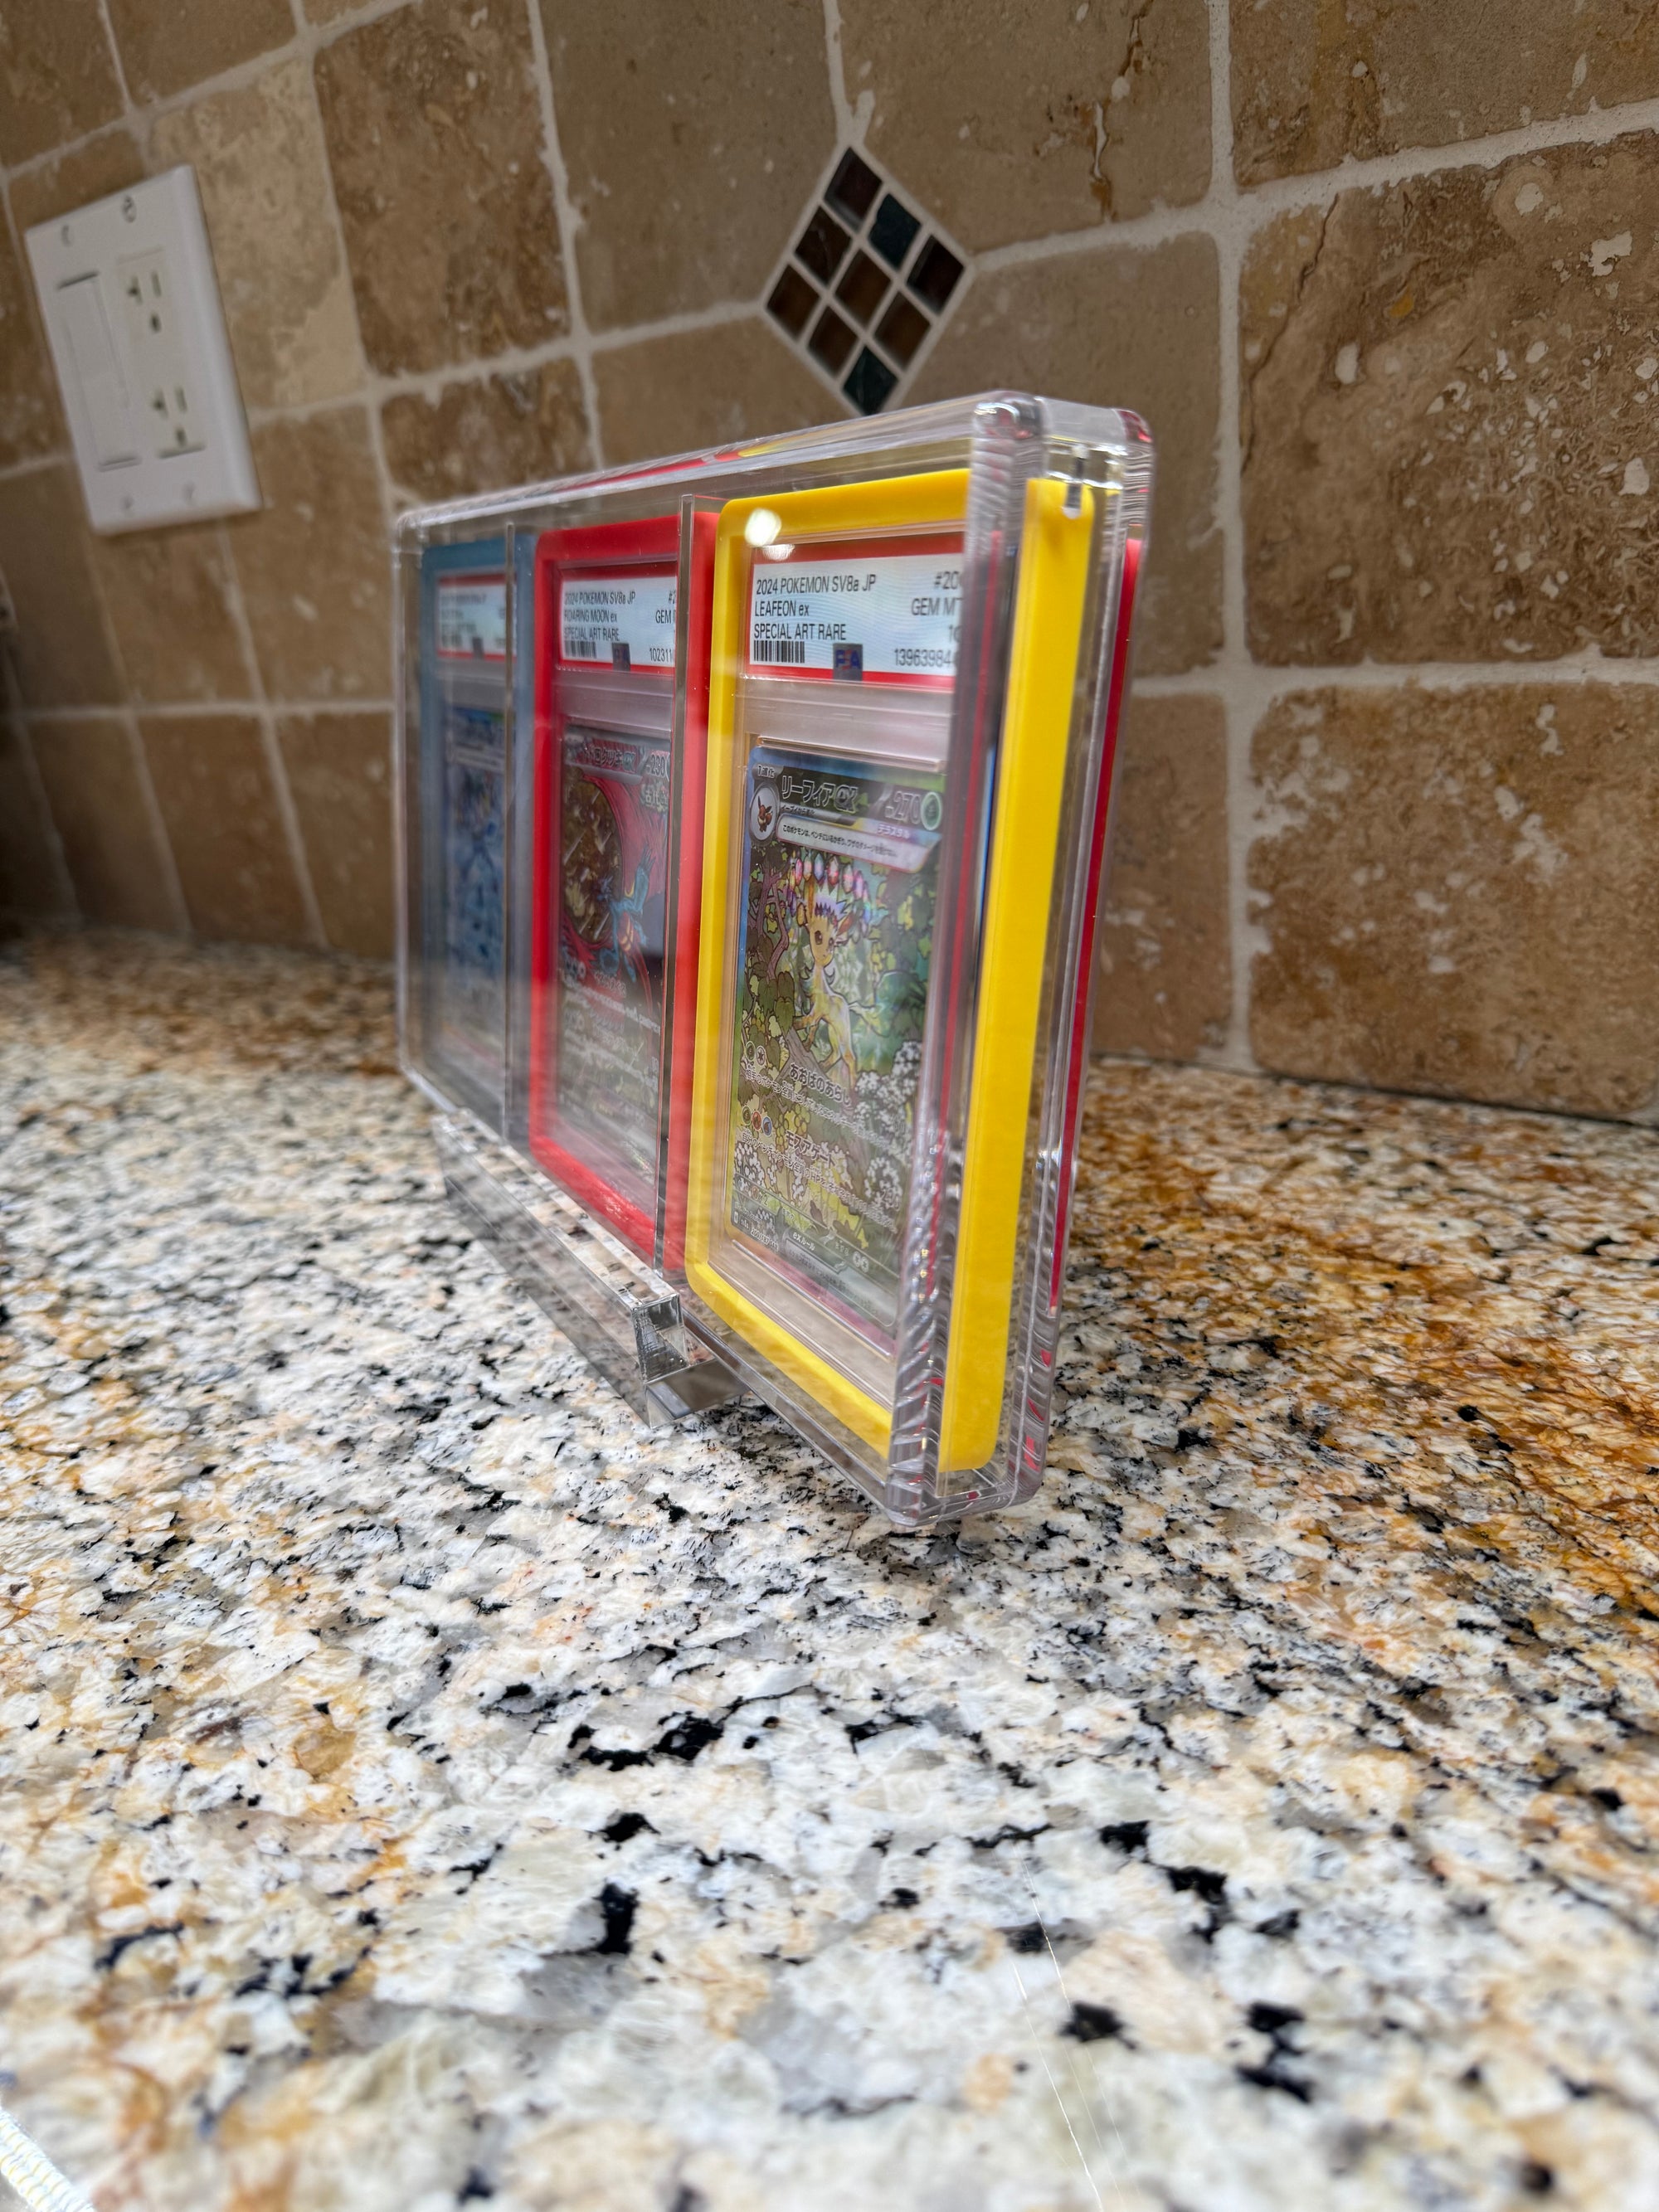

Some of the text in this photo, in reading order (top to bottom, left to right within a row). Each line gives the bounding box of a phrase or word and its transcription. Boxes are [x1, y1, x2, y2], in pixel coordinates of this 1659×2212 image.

[756, 574, 877, 596] 2024 POKEMON SV8a JP
[580, 591, 608, 605] POKEMON
[627, 591, 636, 605] JP
[912, 597, 939, 616] GEM
[591, 610, 610, 622] MOON
[611, 613, 618, 622] ex
[655, 610, 672, 624] GEM
[755, 600, 810, 617] LEAFEON ex
[589, 628, 601, 640] ART
[603, 628, 620, 641] RARE
[754, 623, 847, 640] SPECIAL ART RARE
[649, 647, 674, 662] 102311
[894, 648, 957, 668] 13963984
[790, 1062, 853, 1107] あおばのあらし
